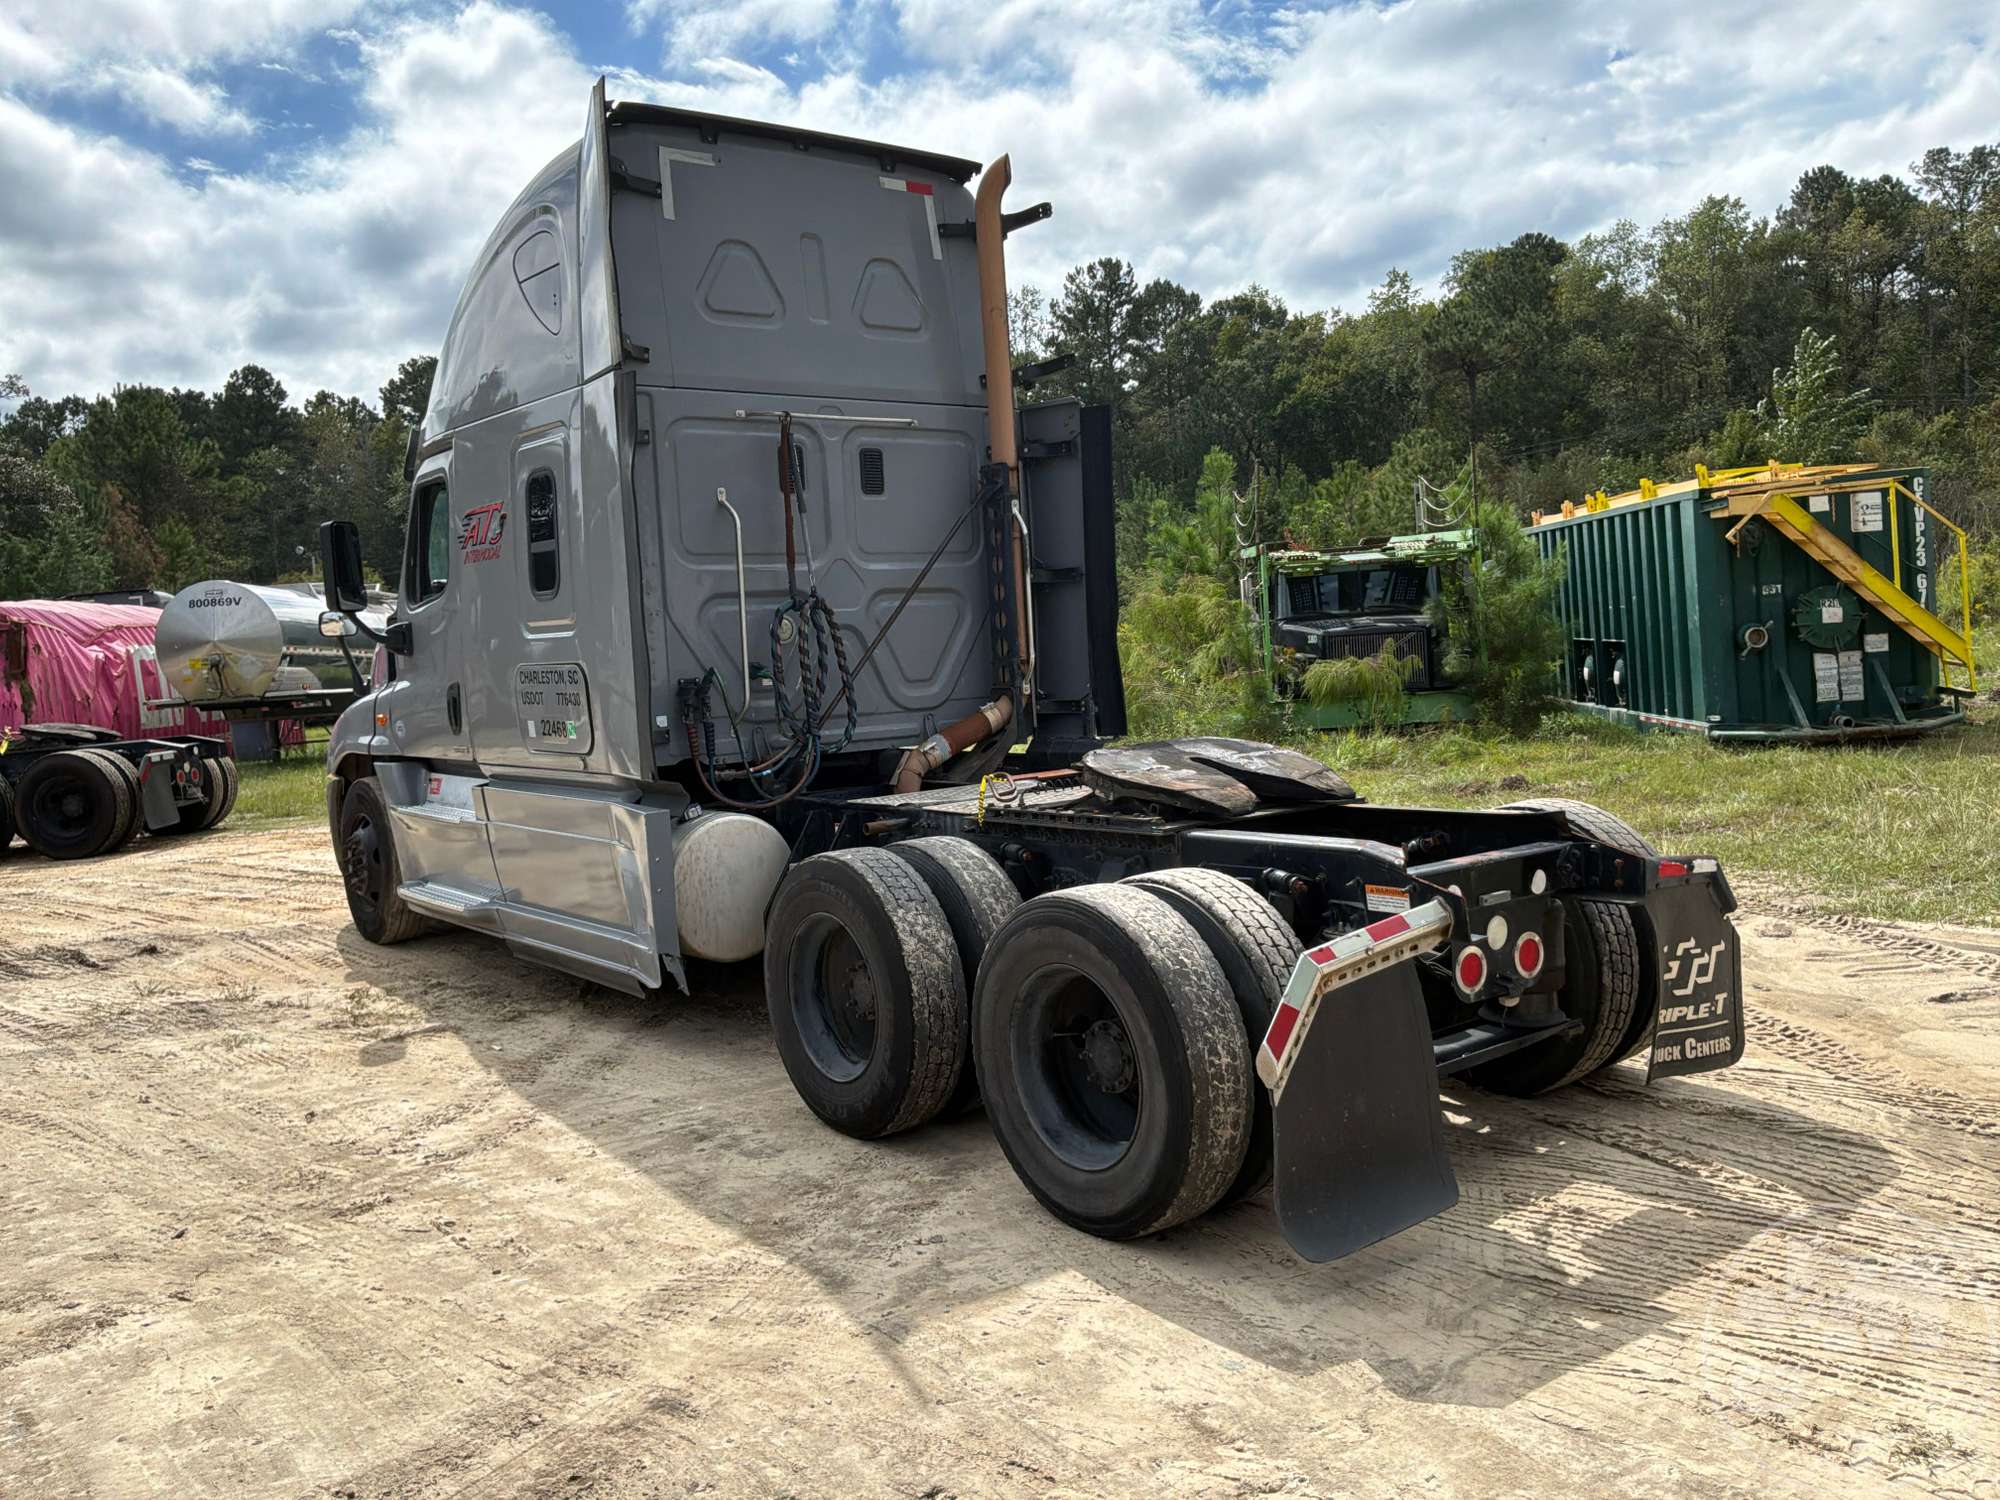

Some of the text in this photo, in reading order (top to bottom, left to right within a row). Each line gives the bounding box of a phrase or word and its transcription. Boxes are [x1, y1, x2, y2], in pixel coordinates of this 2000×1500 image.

[188, 596, 242, 609] 800869V
[519, 670, 579, 685] CHARLESTON, SC
[521, 690, 544, 705] USDOT
[541, 719, 568, 738] 22468
